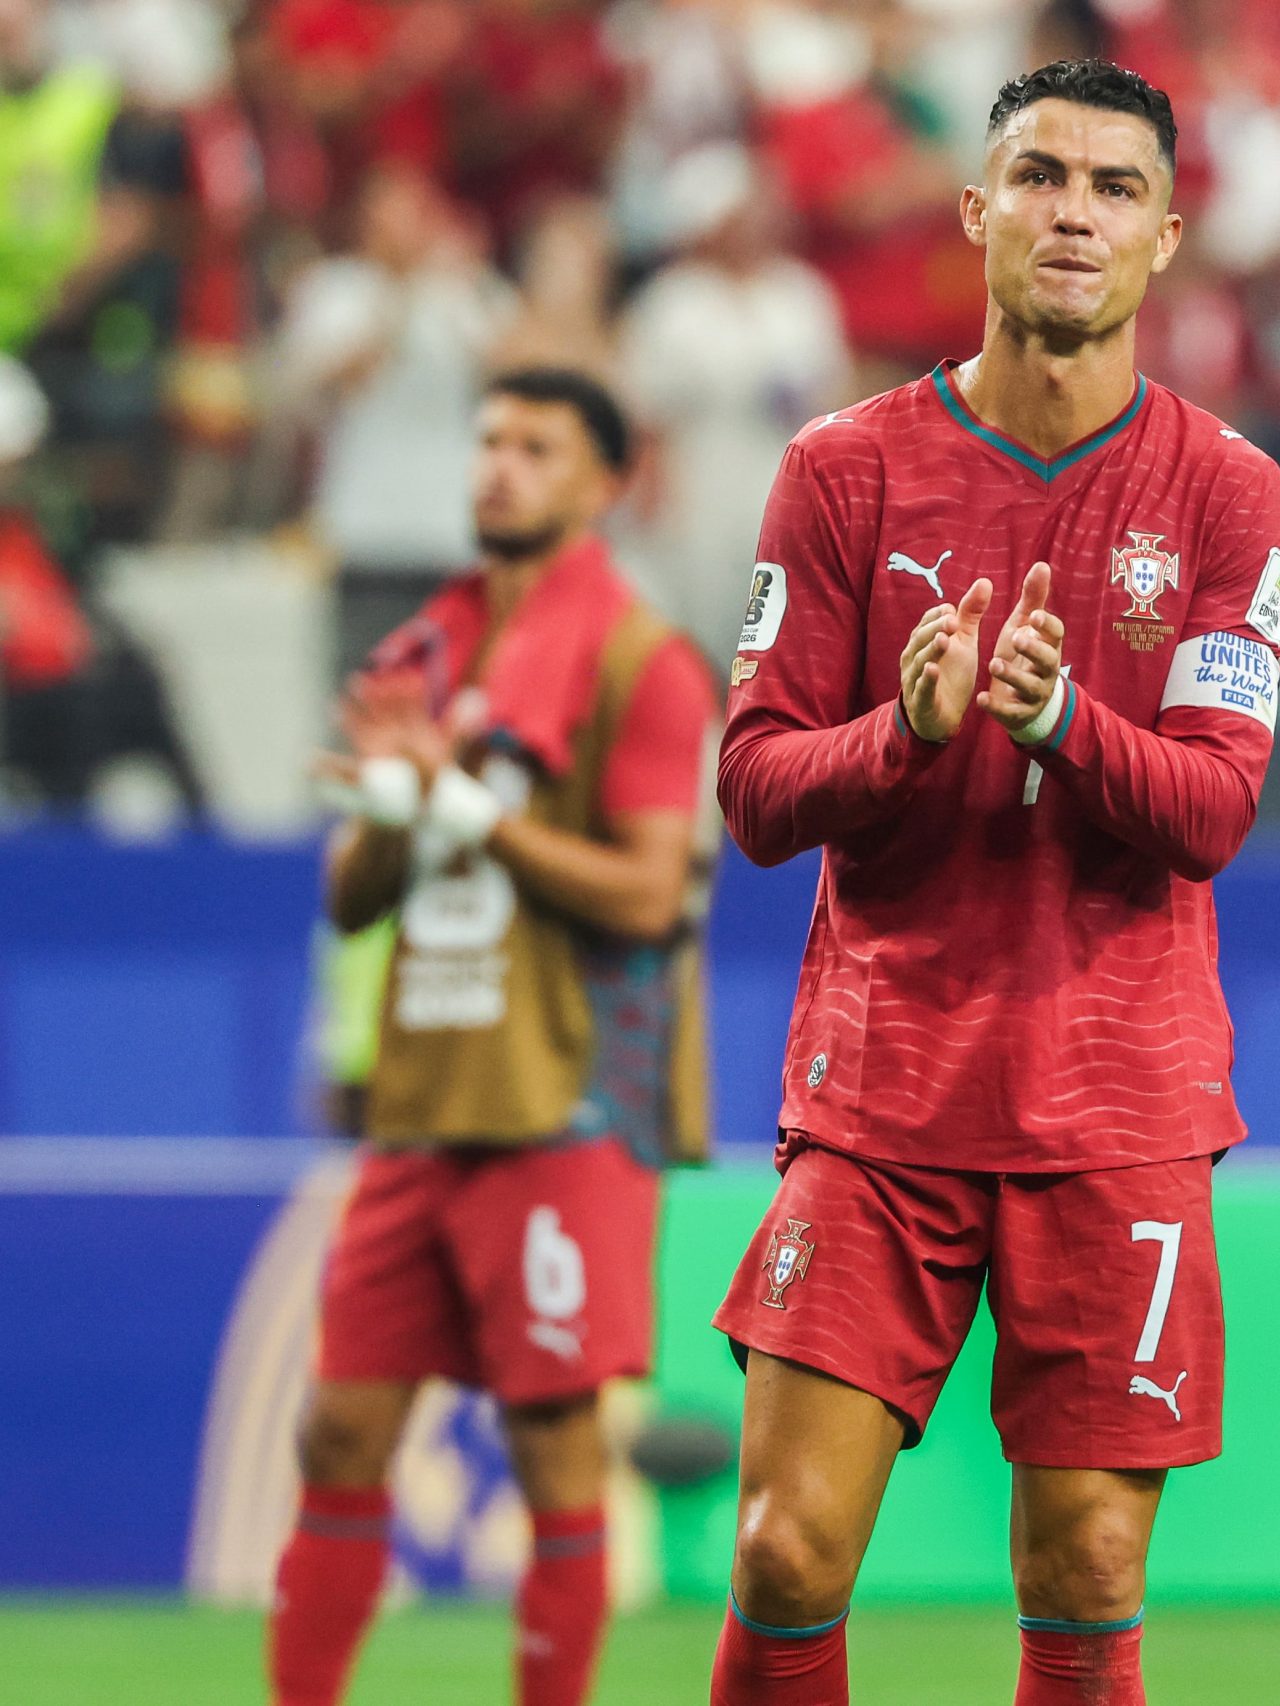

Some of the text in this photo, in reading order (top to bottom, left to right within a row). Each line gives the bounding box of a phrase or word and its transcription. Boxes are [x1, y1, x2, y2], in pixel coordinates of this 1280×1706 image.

[1201, 643, 1271, 684] UNITES
[1193, 665, 1274, 705] the World
[1224, 692, 1253, 707] FIFA
[522, 1205, 587, 1319] 6
[1131, 1220, 1183, 1362] 7
